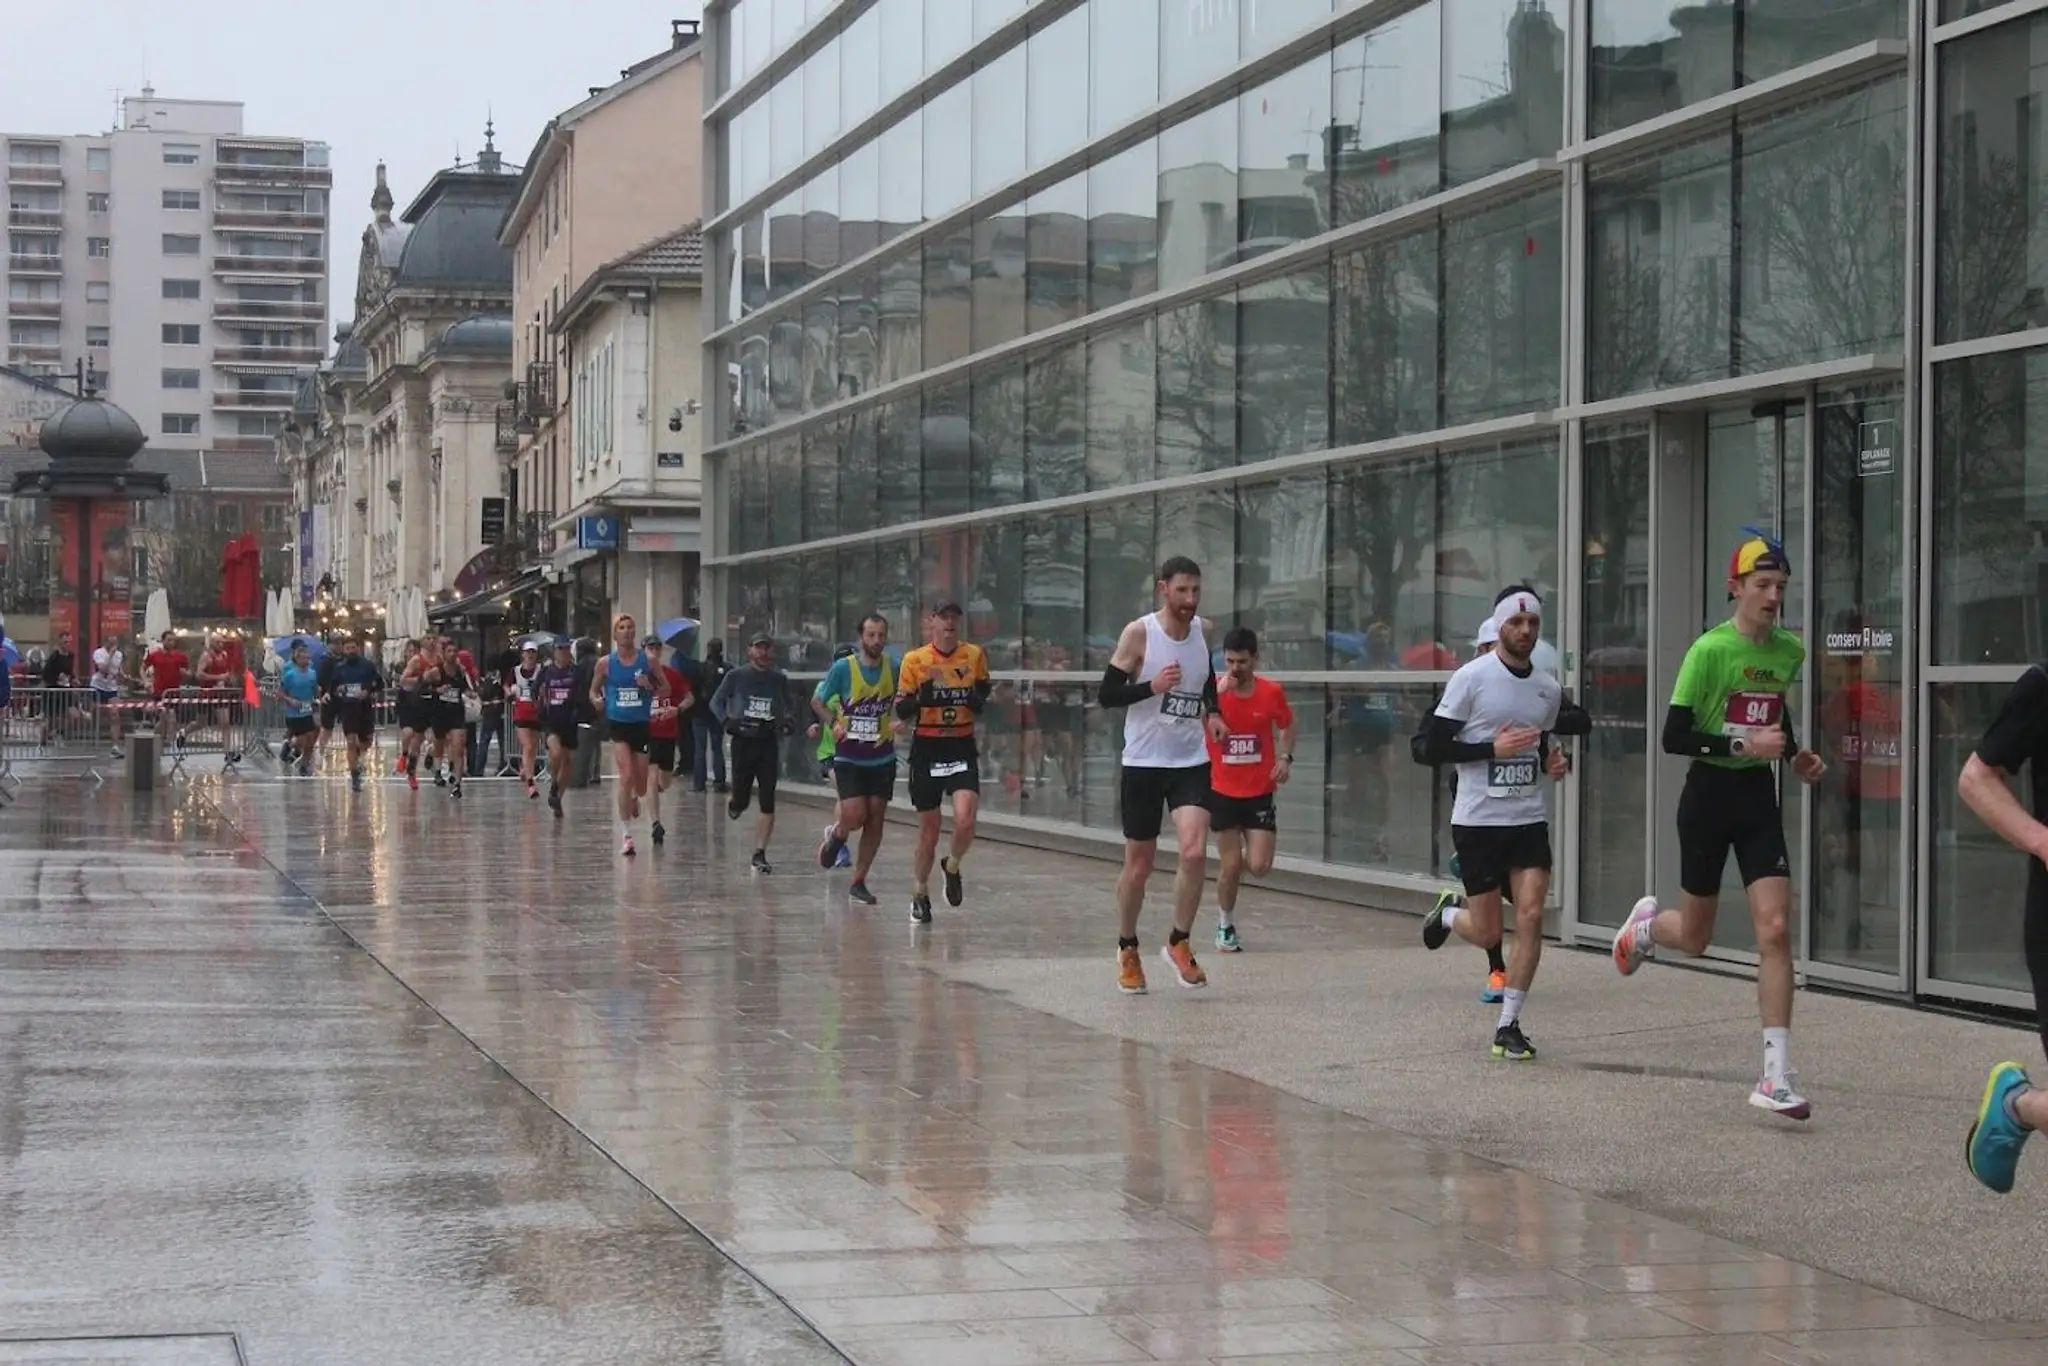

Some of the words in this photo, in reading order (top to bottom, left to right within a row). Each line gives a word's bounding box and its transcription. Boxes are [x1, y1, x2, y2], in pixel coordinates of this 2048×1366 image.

[1873, 428, 1879, 445] 1
[1746, 701, 1769, 723] 94
[1229, 740, 1254, 754] 304
[1494, 764, 1533, 784] 2093
